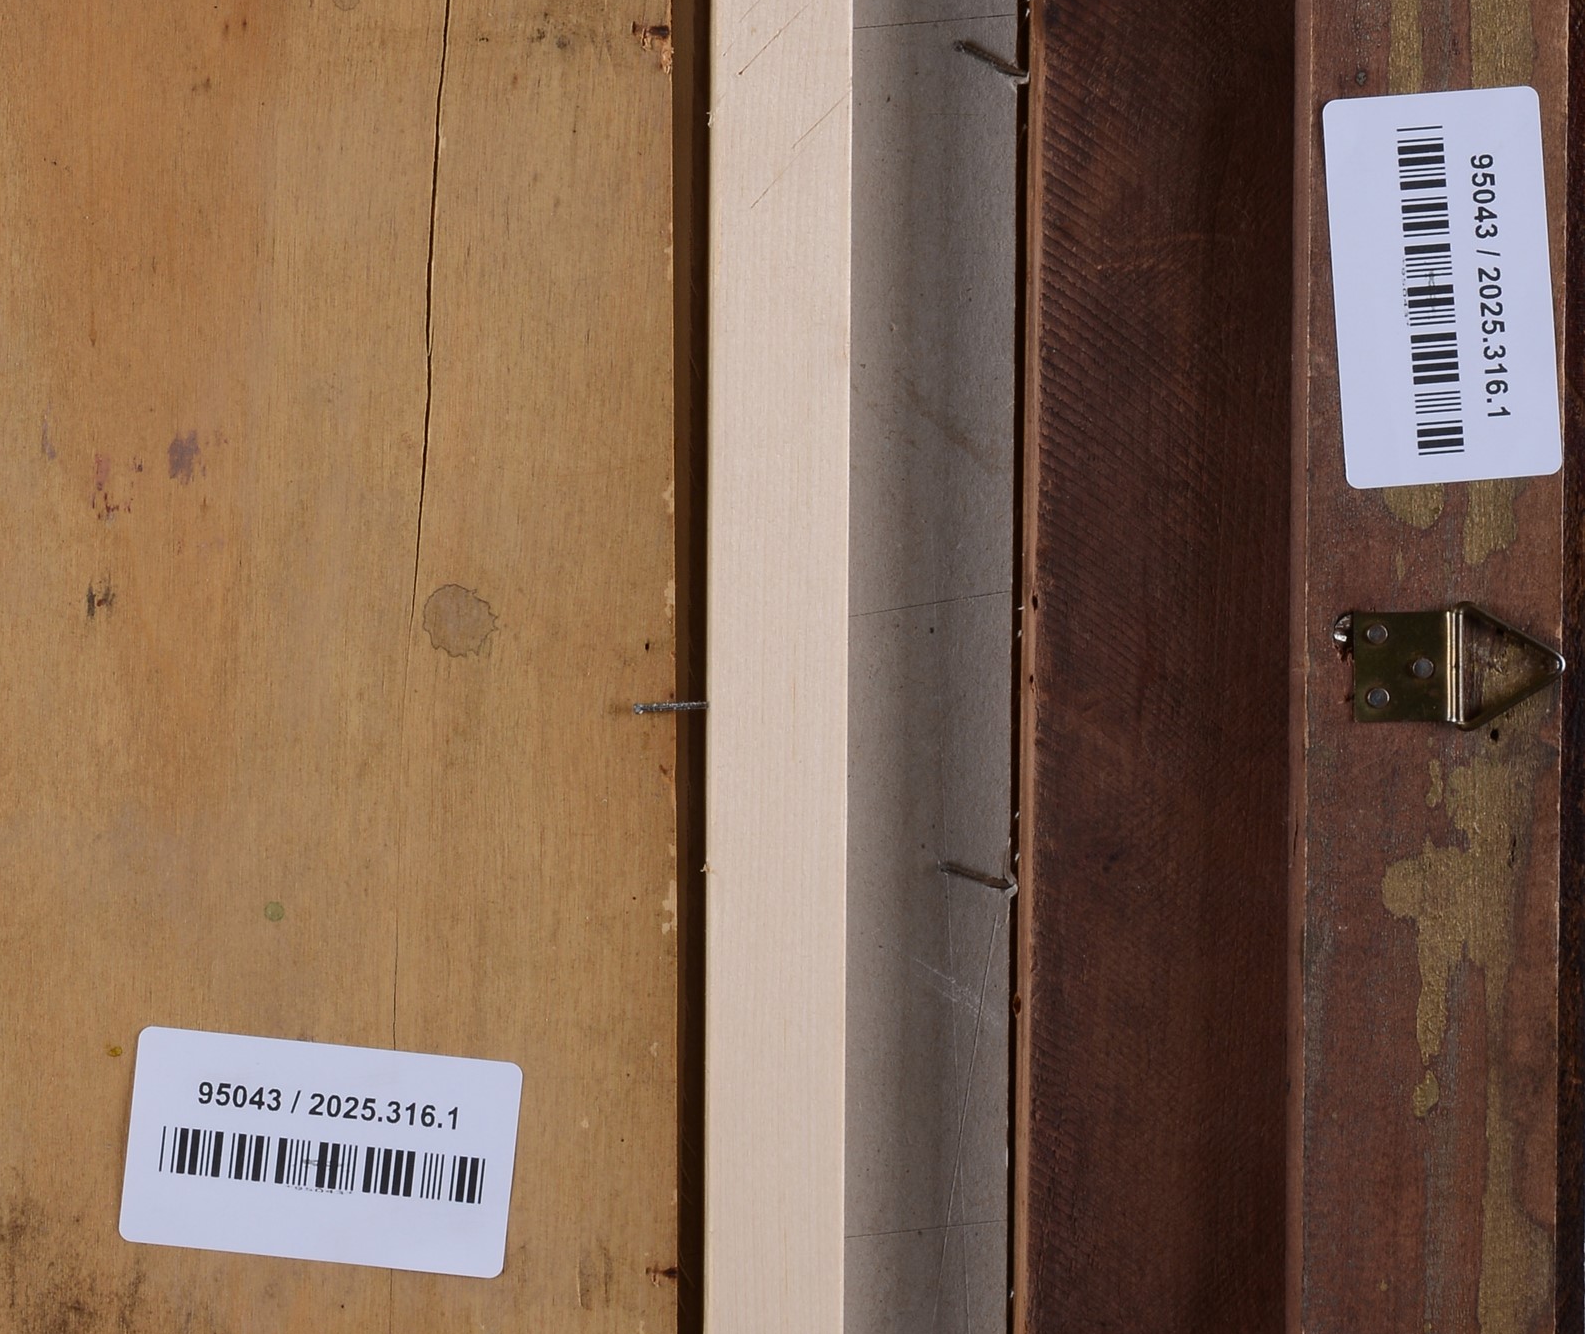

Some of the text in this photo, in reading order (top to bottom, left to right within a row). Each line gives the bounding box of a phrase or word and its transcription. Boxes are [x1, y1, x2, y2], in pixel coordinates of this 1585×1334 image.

[1470, 153, 1512, 419] 95043 / 2025.316.1
[197, 1081, 459, 1131] 95043 / 2025.316.1
